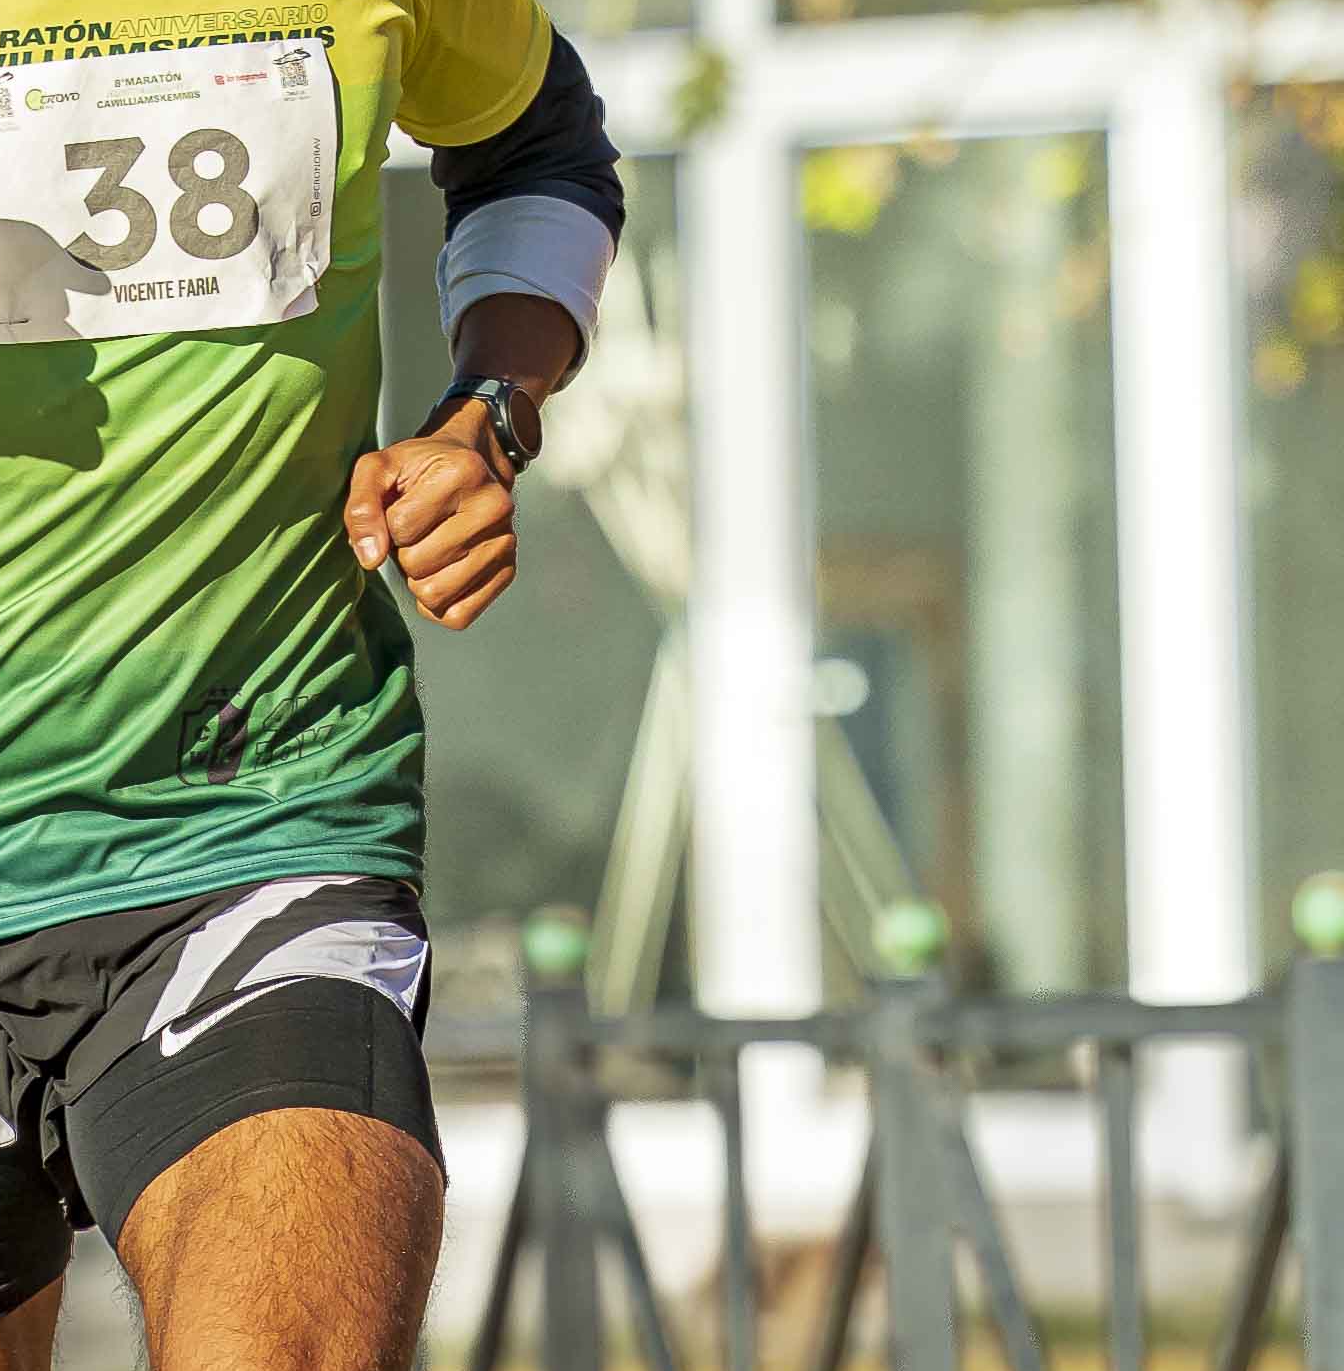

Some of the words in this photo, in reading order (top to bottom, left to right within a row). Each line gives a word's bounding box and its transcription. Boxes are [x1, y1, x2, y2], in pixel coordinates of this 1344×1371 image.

[64, 128, 260, 272] 38
[113, 281, 174, 303] VICENTE
[179, 276, 220, 297] FARIA
